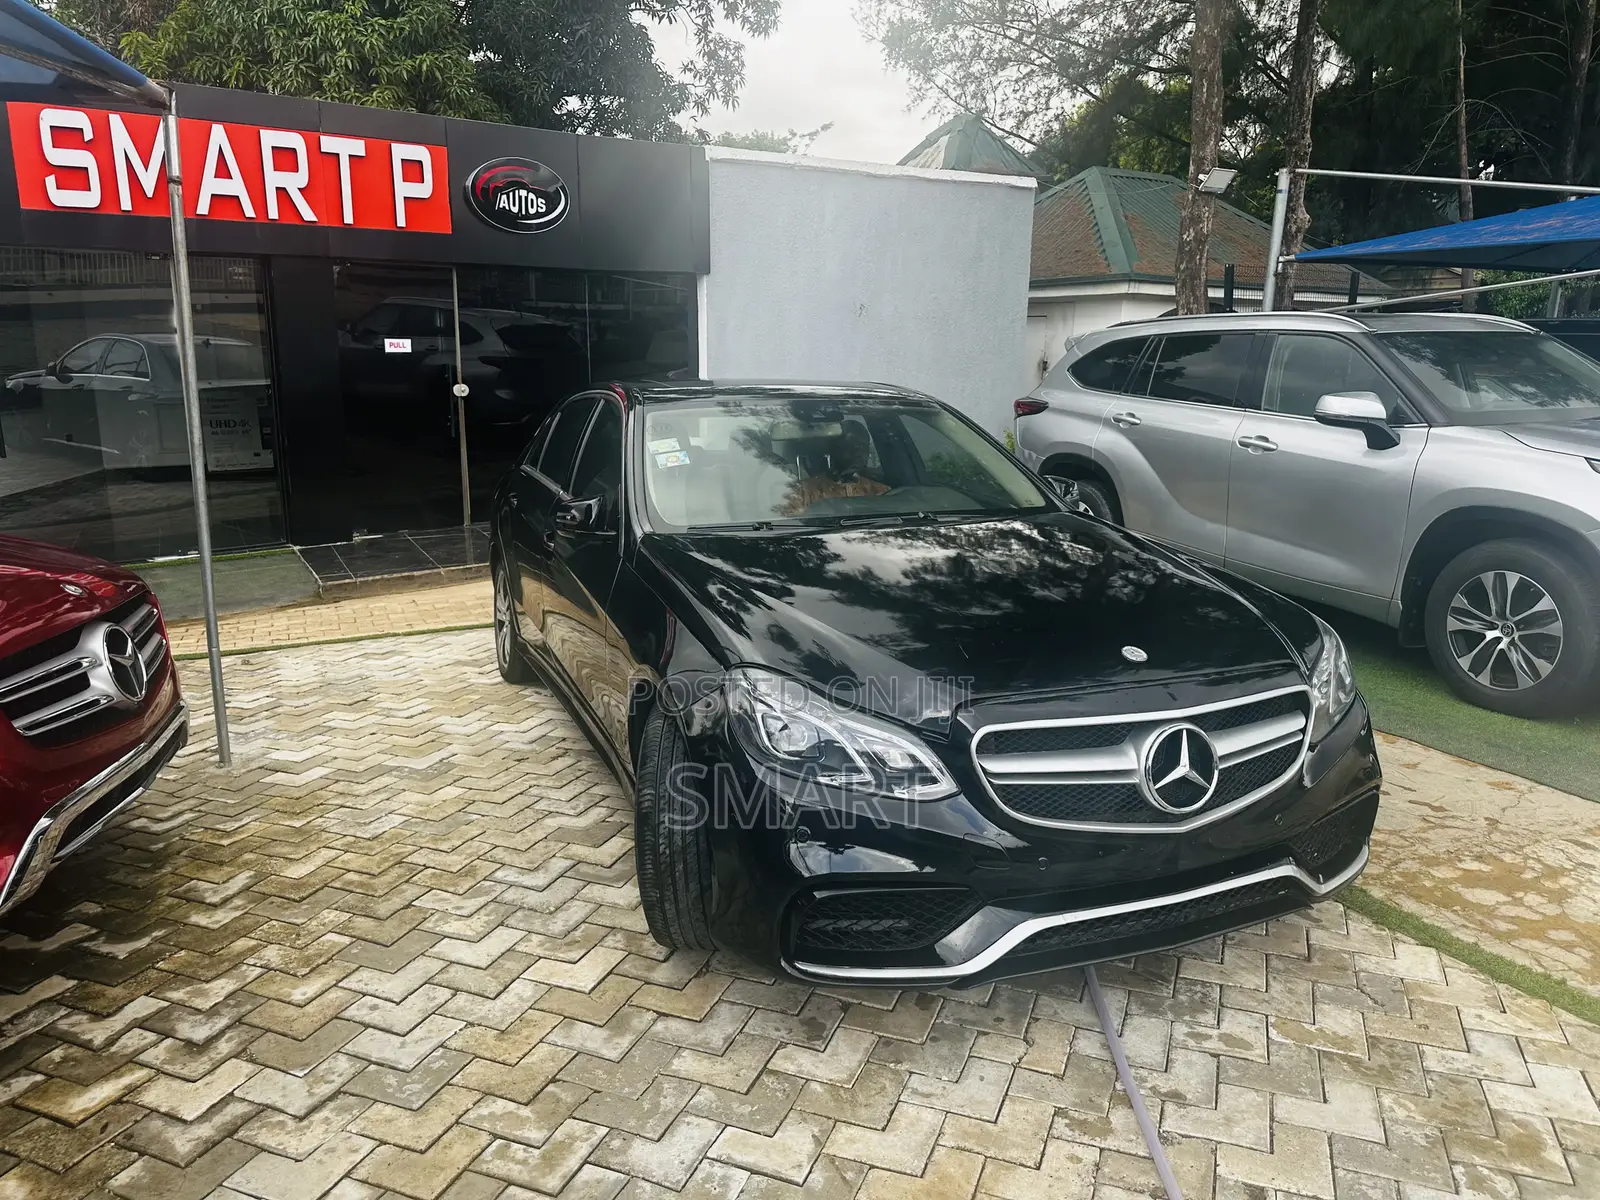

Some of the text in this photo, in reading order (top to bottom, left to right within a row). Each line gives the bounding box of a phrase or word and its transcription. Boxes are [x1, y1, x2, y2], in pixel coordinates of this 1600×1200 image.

[39, 108, 433, 227] SMART P
[499, 189, 546, 215] AUTOS
[389, 341, 407, 349] PULL
[209, 419, 237, 429] UHD
